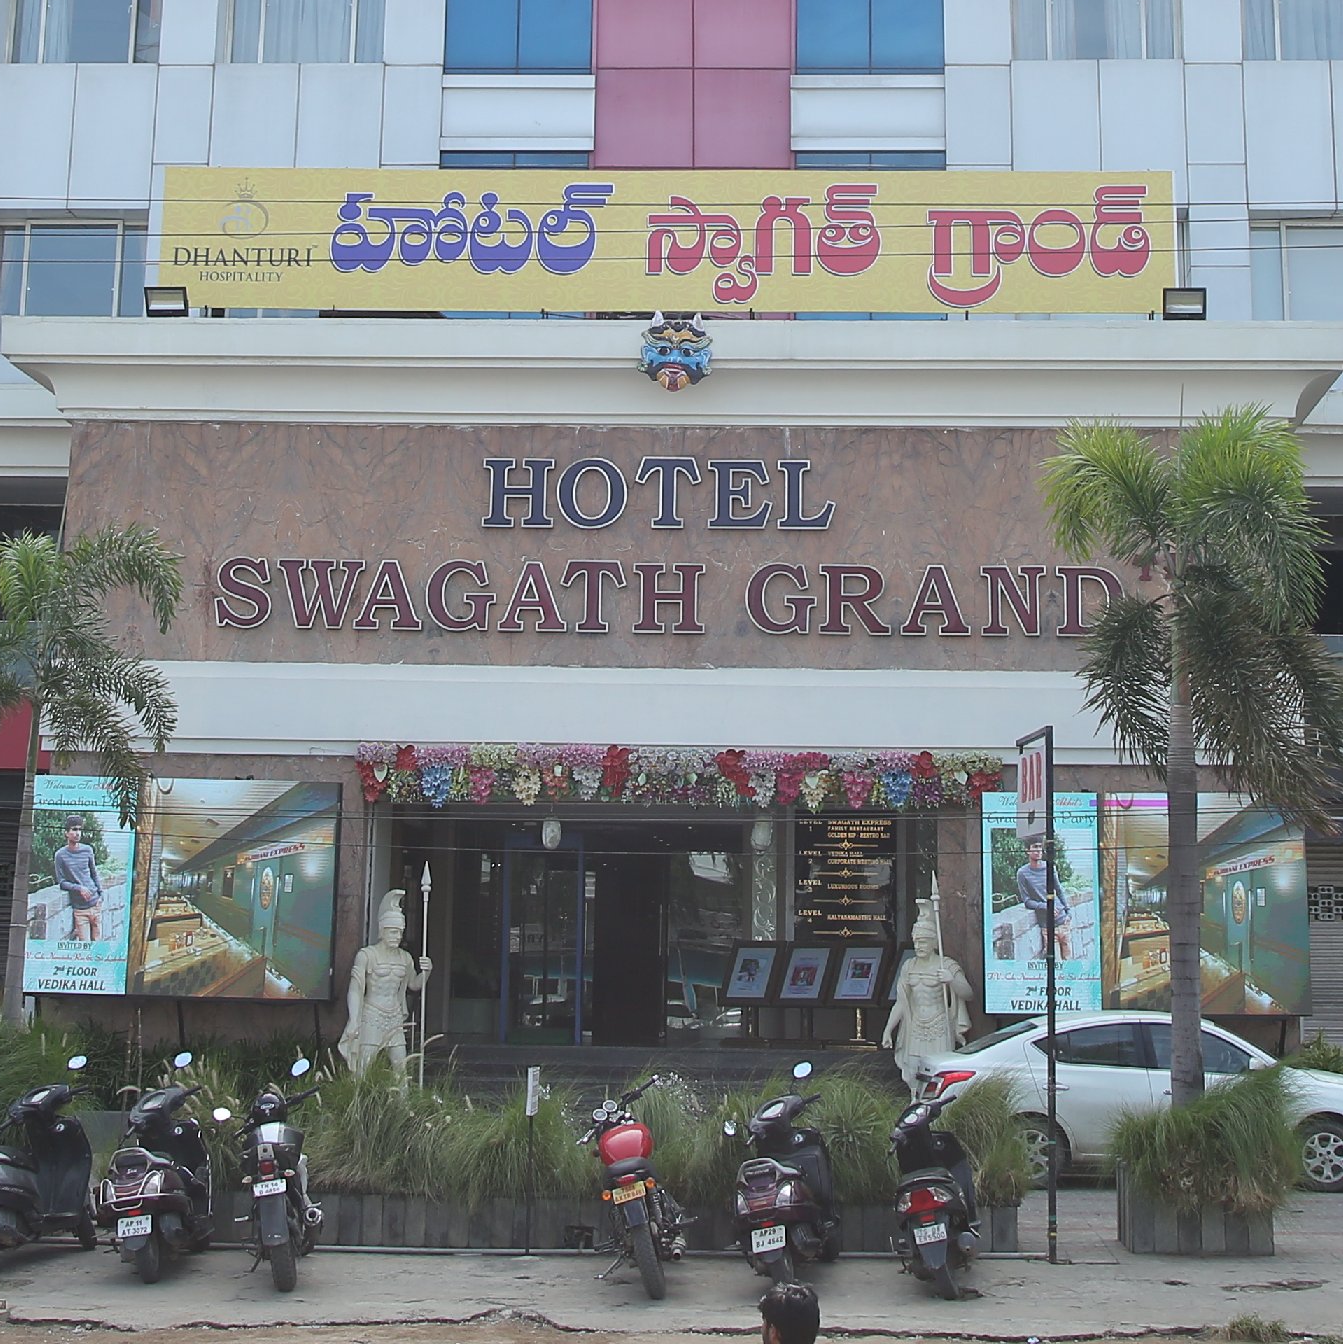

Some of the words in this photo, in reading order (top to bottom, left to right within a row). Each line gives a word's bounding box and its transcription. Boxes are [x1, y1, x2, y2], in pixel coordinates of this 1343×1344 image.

[330, 183, 615, 274] హోటల్
[645, 184, 882, 304] స్వాగత్
[927, 185, 1152, 307] గ్రాండ్
[173, 247, 313, 268] DHANTURI
[199, 271, 284, 283] HOSPITALITY
[482, 457, 836, 530] HOTEL
[215, 557, 706, 634] SWAGATH
[745, 562, 1126, 637] GRAND
[1021, 752, 1042, 804] BAR
[1062, 811, 1095, 826] Party
[66, 966, 97, 976] FLOOR
[38, 979, 76, 990] VEDIKA
[79, 980, 106, 990] HALL
[1055, 1000, 1081, 1010] HALL
